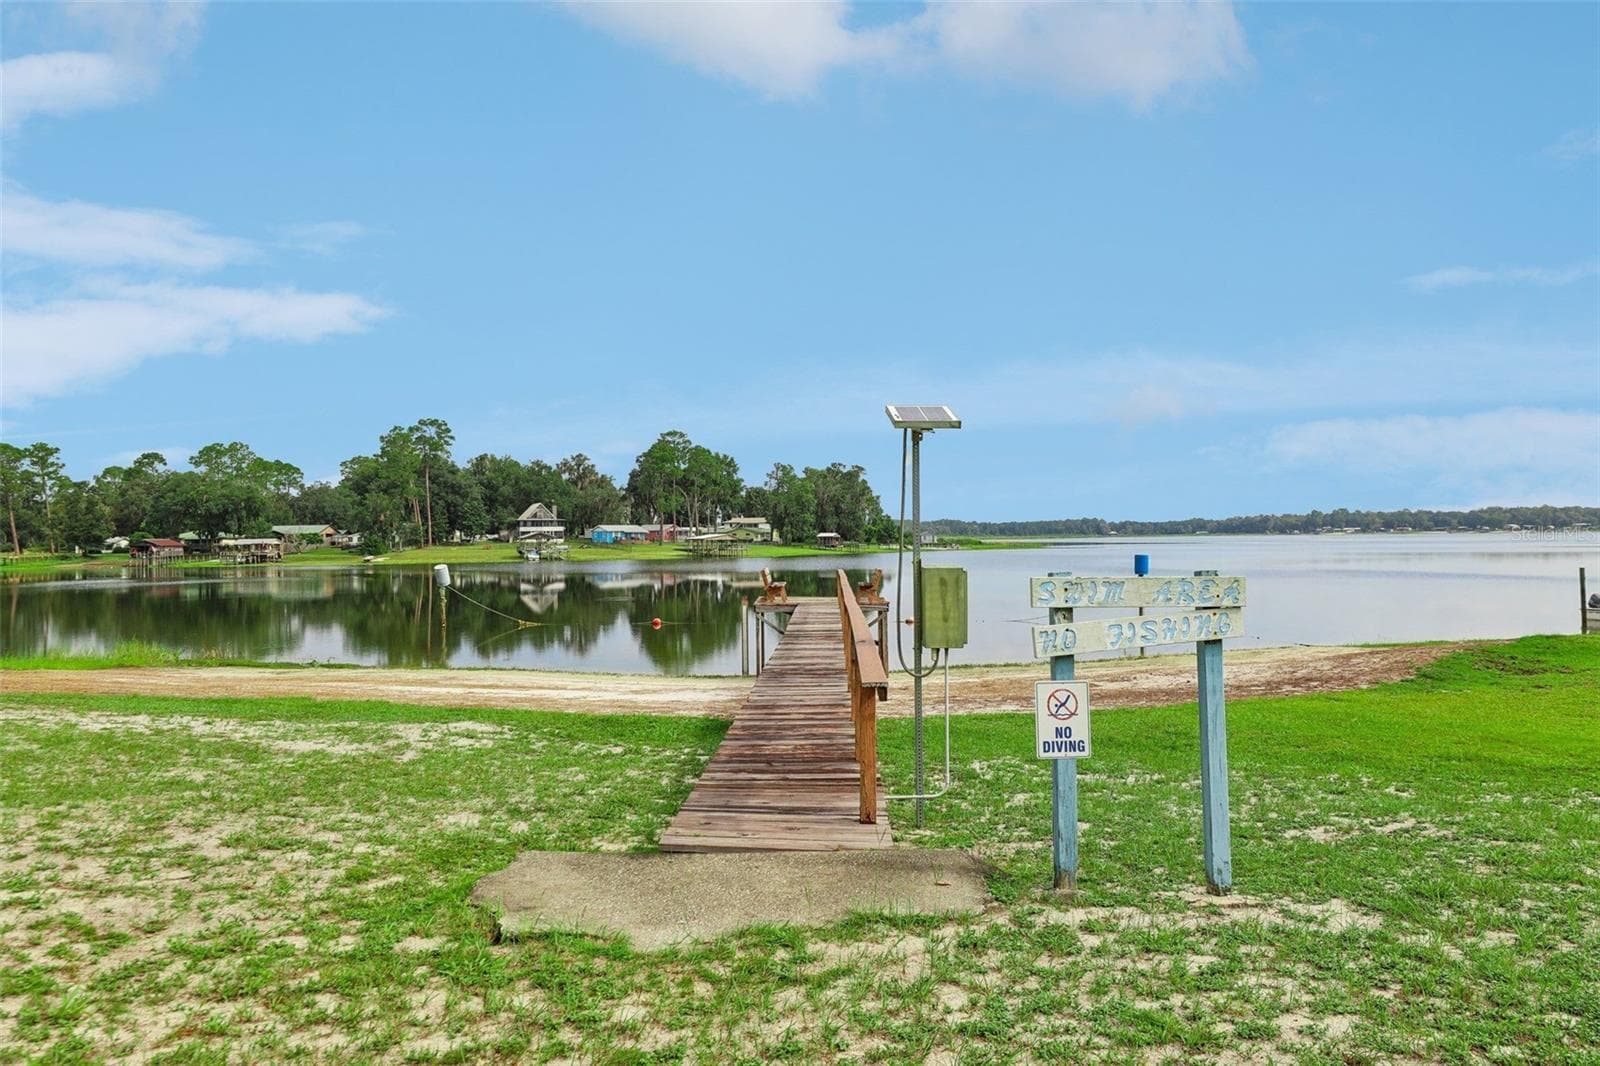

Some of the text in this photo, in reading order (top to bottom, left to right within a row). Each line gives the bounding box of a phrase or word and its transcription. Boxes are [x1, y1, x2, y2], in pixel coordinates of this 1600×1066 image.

[1038, 579, 1240, 605] SWIM AREA
[1039, 612, 1233, 652] NO FISHING
[1055, 726, 1072, 739] NO
[1043, 740, 1085, 753] DIVING
